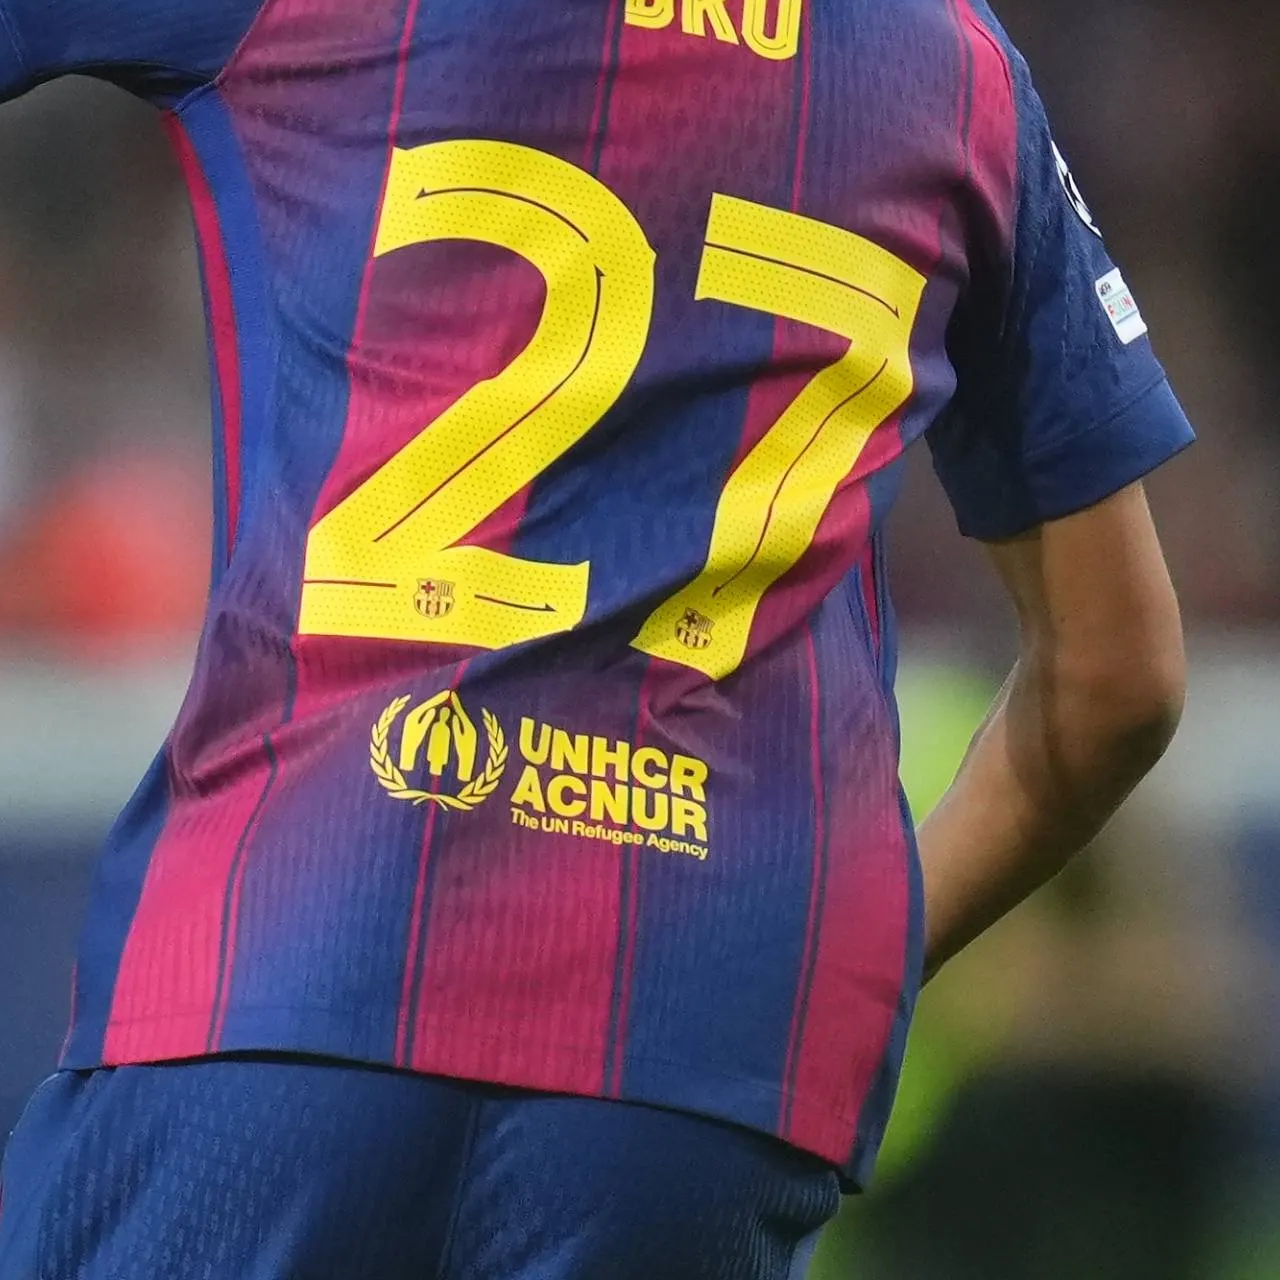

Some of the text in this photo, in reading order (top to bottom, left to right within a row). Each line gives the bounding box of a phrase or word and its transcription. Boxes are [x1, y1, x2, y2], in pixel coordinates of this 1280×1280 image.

[298, 139, 927, 681] 27
[519, 717, 708, 801] UNHCR
[510, 765, 708, 841] ACNUR
[510, 807, 708, 860] The UN Refugee Agency
